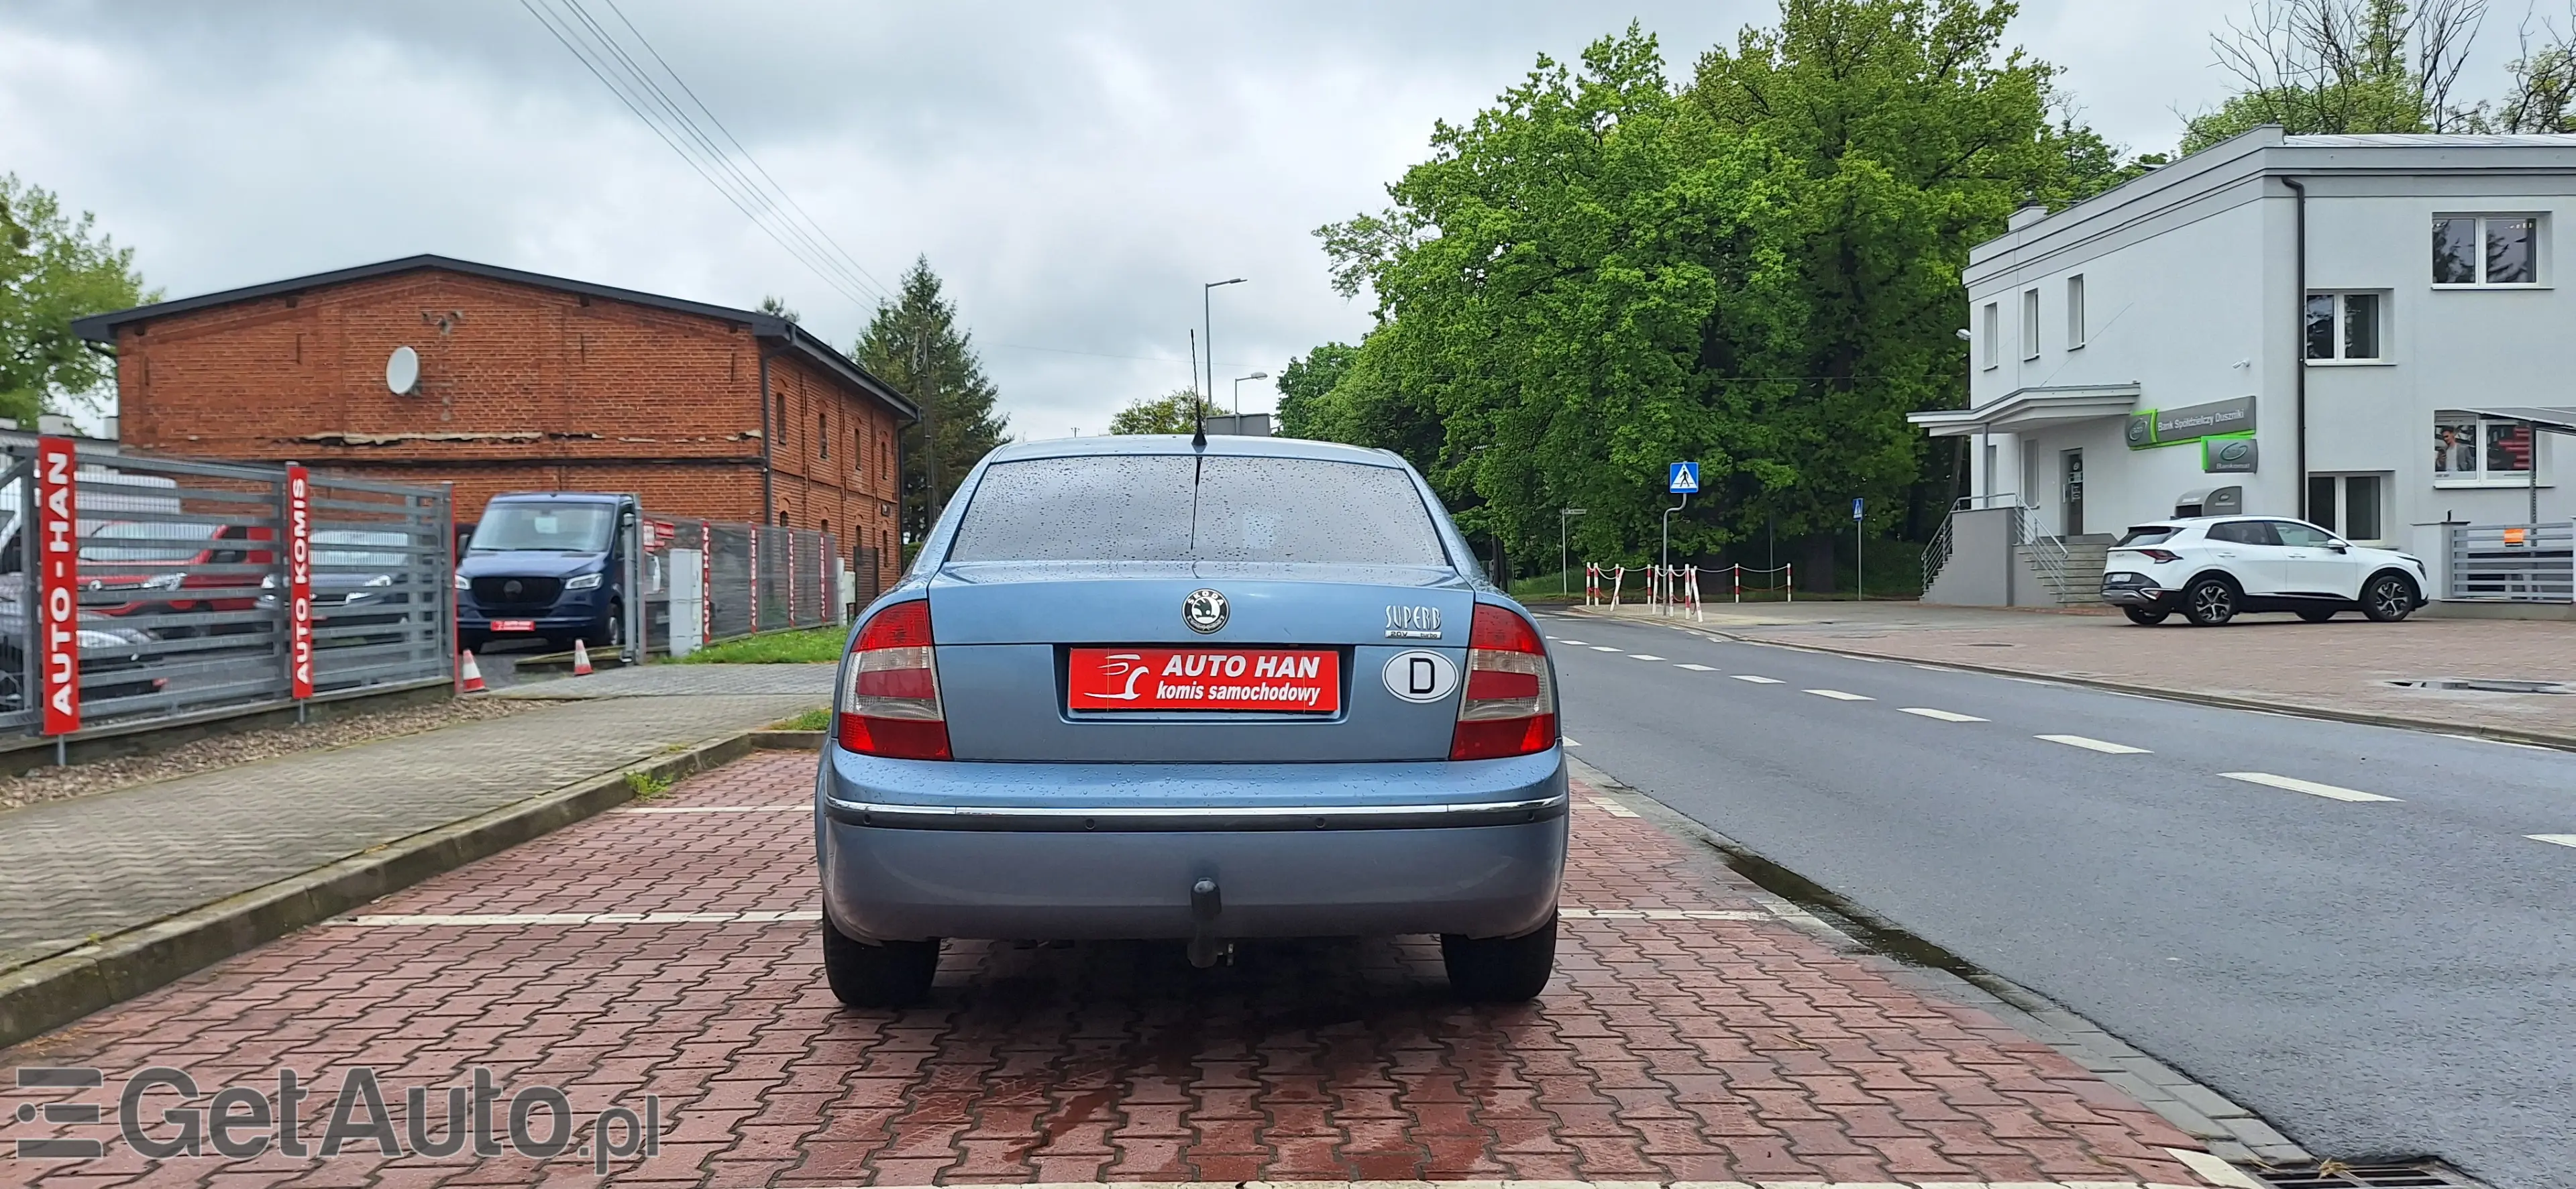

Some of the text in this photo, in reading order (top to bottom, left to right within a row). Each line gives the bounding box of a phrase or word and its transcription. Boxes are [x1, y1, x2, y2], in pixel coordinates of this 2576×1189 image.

[2157, 420, 2174, 432] Bank
[2215, 408, 2245, 422] Duszniki
[48, 453, 70, 553] HAN
[292, 477, 311, 685] AUTO KOMIS
[1385, 605, 1442, 630] SUPERB
[51, 585, 72, 716] AUTO
[1161, 655, 1320, 678] AUTO HAN
[1409, 658, 1435, 693] D
[1157, 681, 1320, 705] komis samochodowy
